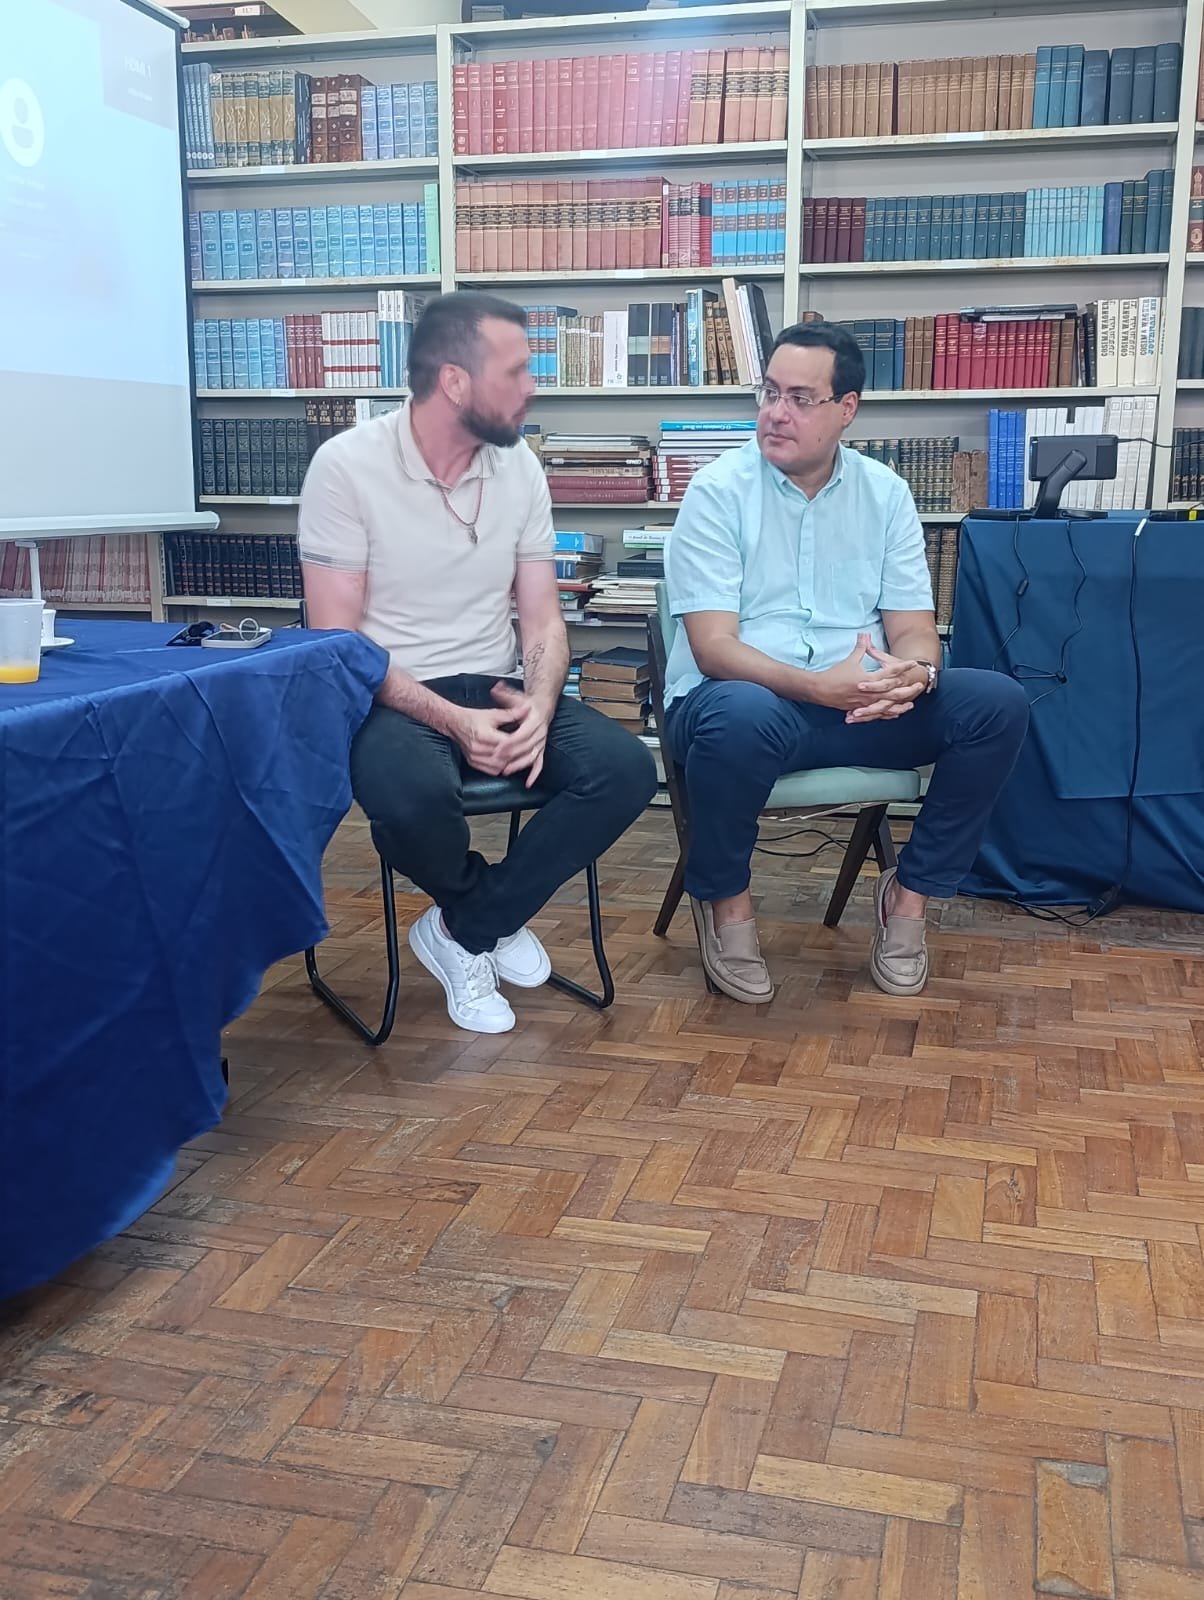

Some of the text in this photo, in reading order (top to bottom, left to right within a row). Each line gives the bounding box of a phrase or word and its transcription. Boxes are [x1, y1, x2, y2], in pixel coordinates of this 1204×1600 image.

[1101, 301, 1109, 357] COSIMA WAGNER
[1120, 301, 1130, 357] COSIMA WAGNER
[1140, 329, 1148, 355] COSIMA
